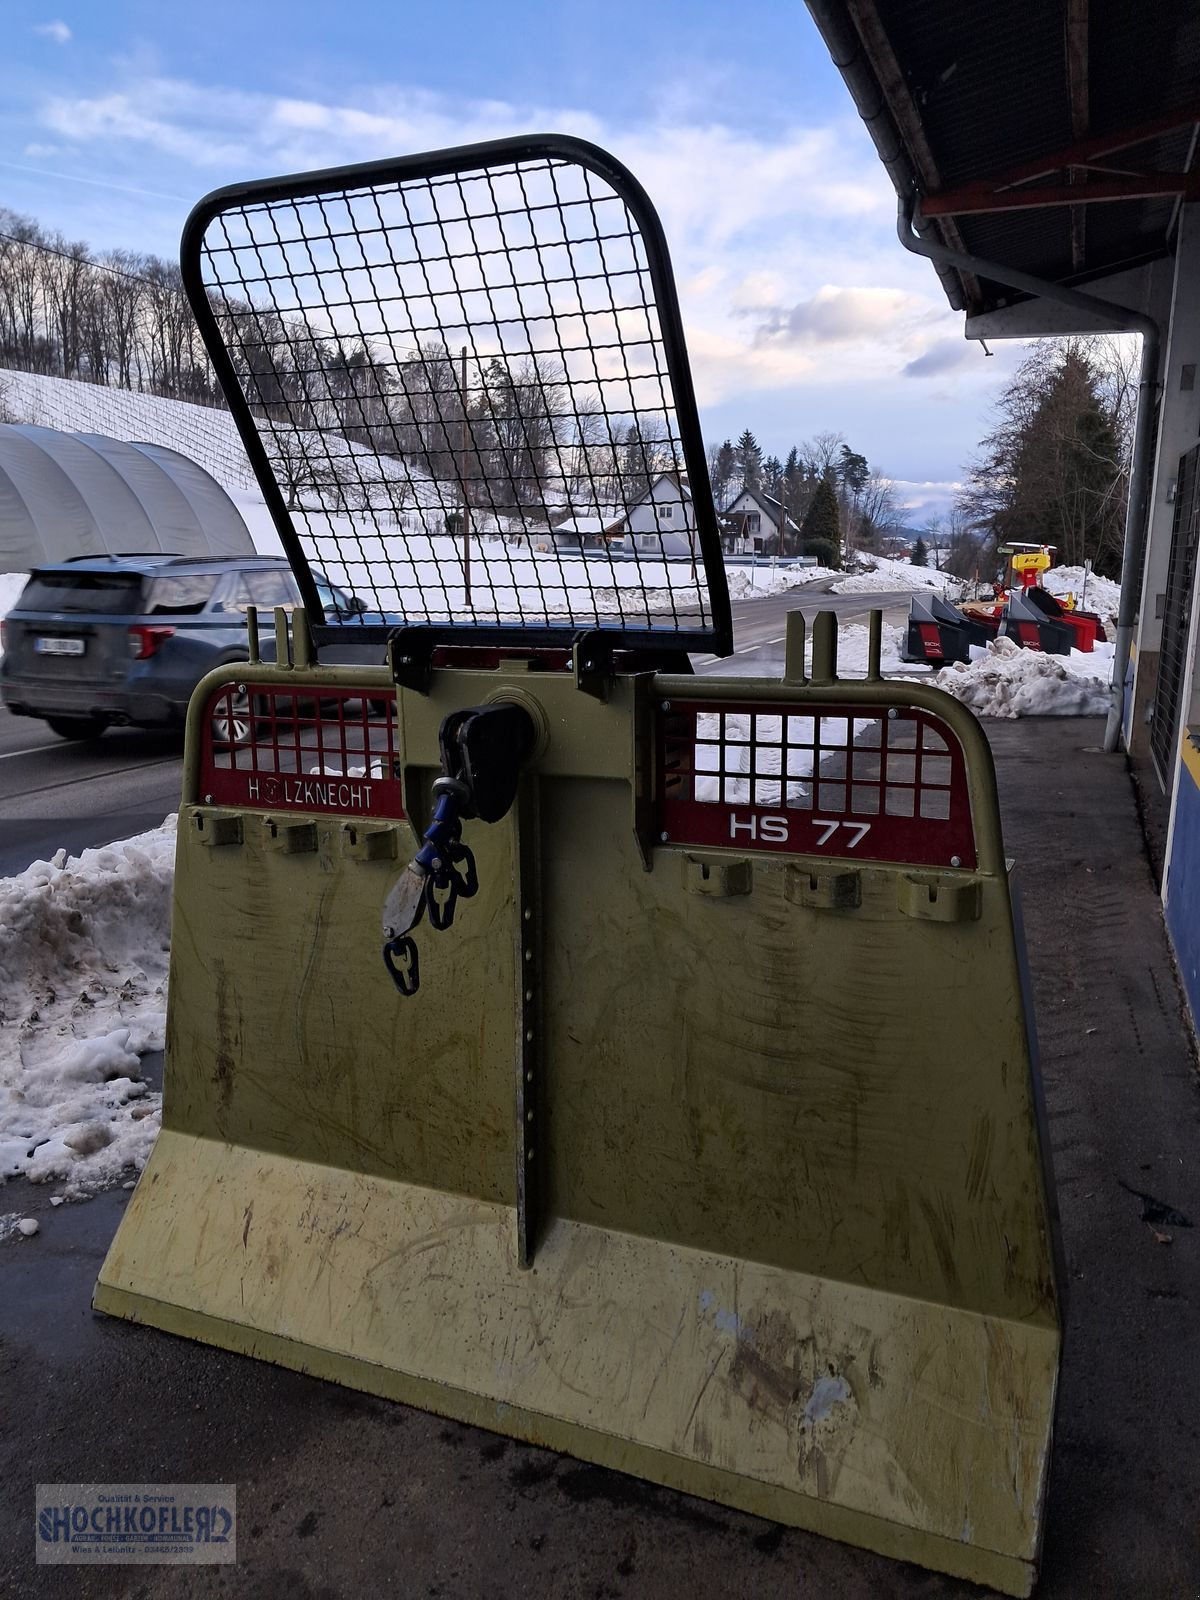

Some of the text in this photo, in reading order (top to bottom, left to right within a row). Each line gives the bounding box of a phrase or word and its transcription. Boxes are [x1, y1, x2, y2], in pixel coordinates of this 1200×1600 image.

[248, 777, 373, 808] HOLZKNECHT
[729, 812, 872, 848] HS 77
